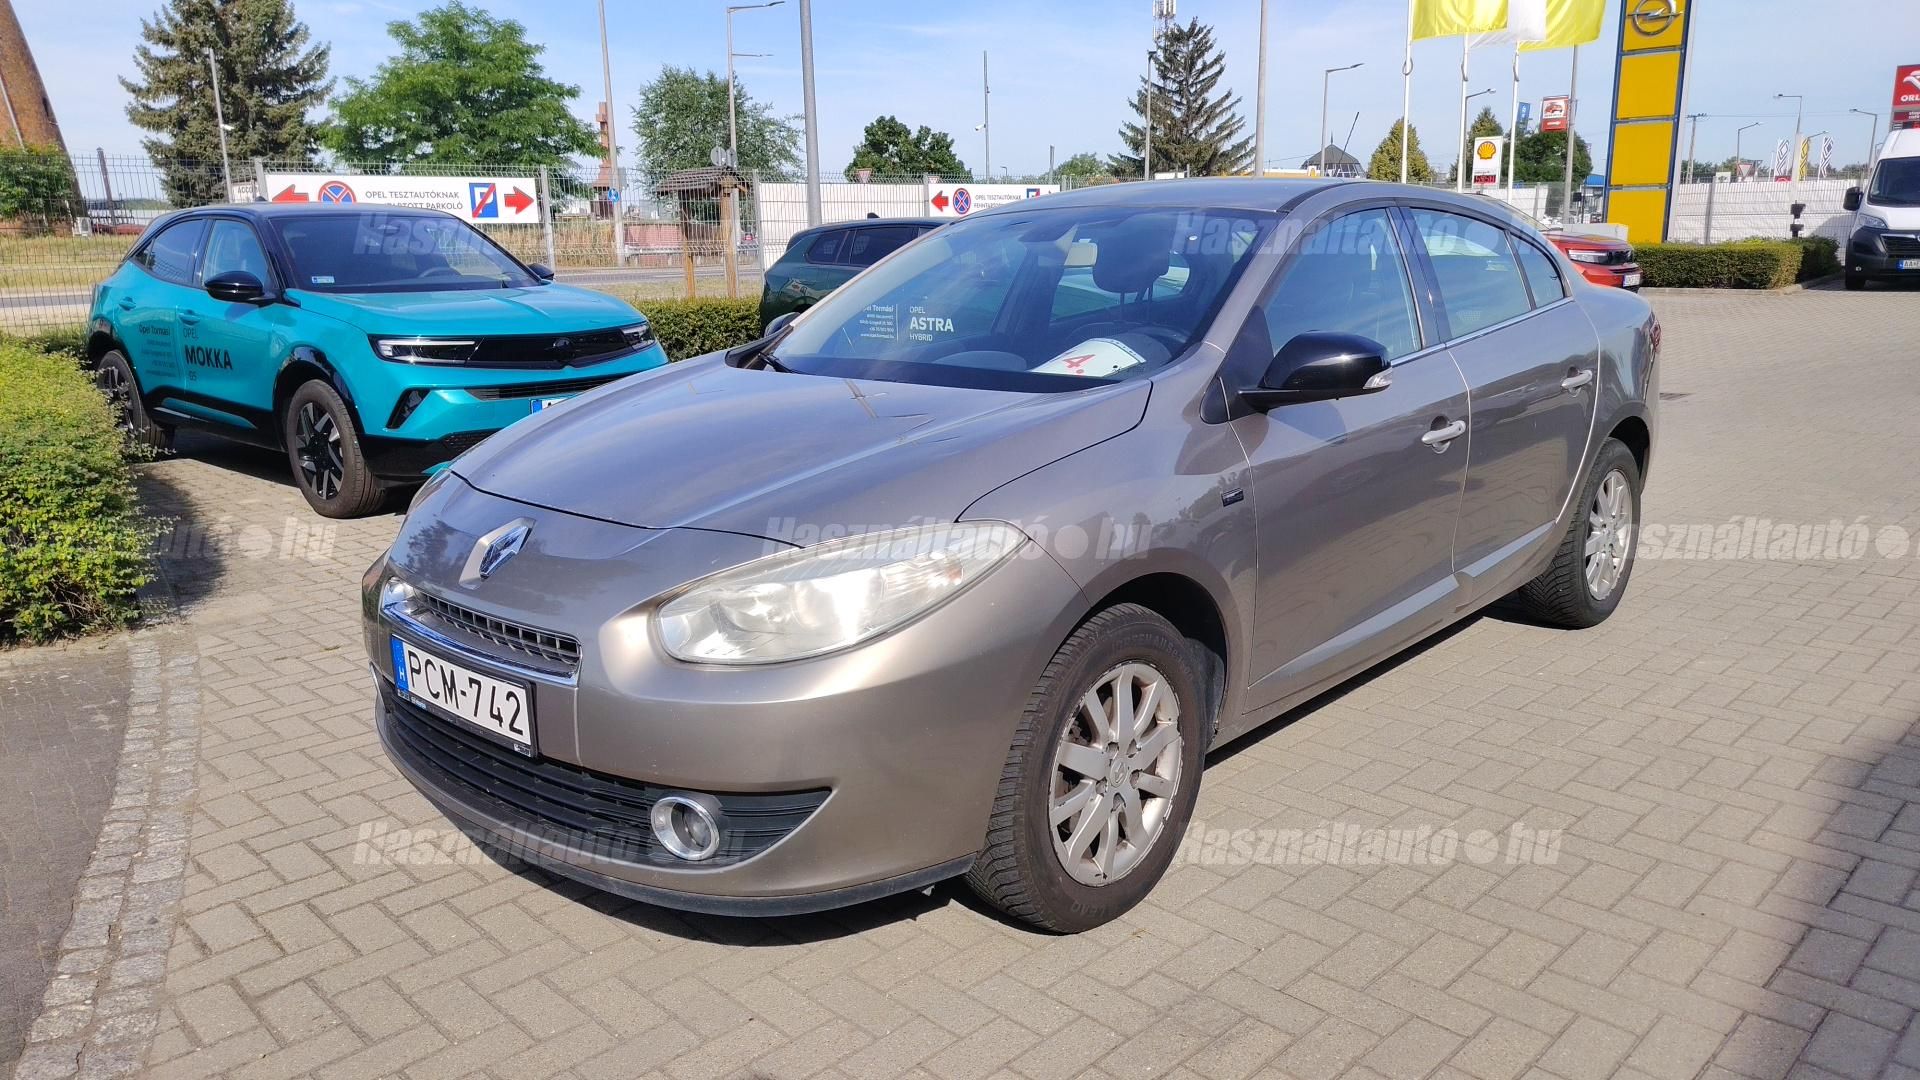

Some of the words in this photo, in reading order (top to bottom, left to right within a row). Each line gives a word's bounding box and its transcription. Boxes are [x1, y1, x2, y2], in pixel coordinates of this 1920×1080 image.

[365, 190, 387, 199] OPEL
[388, 189, 460, 199] TESZTAUTÓKNAK
[909, 305, 926, 314] OPEL
[909, 316, 955, 333] ASTRA
[182, 327, 200, 339] OPEL
[909, 333, 933, 342] HYBRID
[184, 344, 233, 370] MOKKA
[398, 666, 406, 681] H
[408, 649, 524, 736] PCM-742
